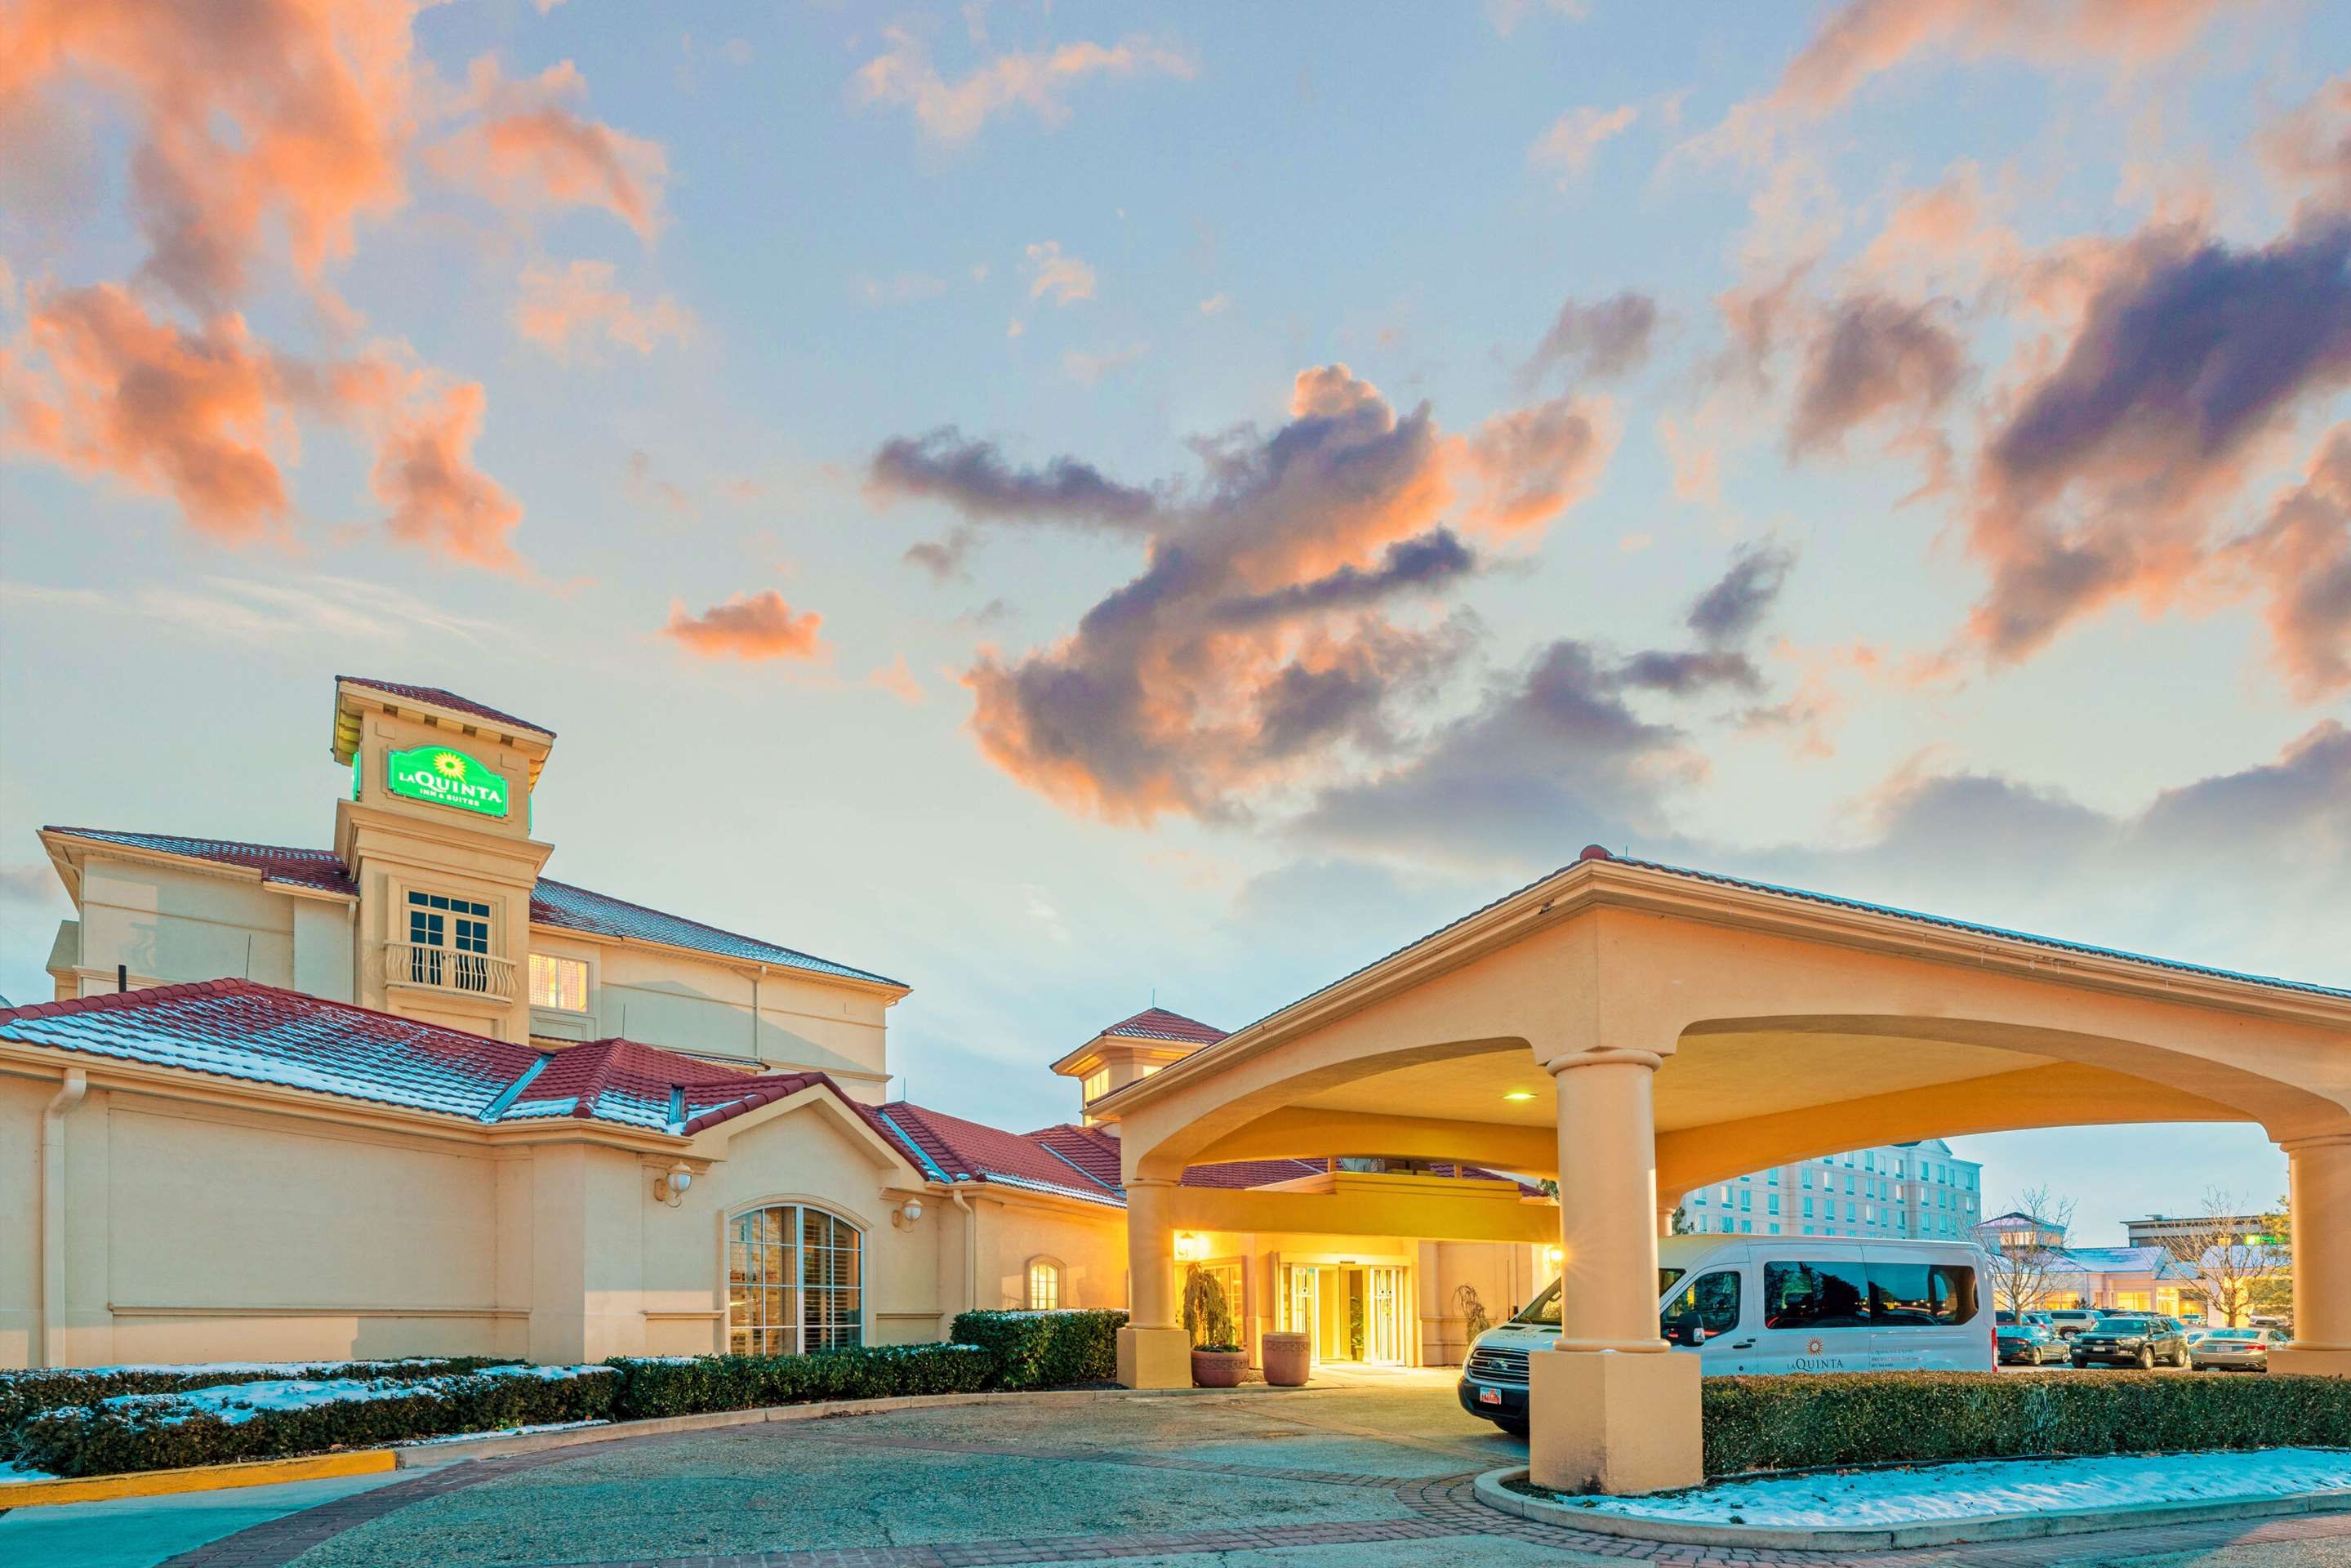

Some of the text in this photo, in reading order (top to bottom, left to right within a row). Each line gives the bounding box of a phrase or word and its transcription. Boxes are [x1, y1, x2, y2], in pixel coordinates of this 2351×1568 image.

[399, 771, 502, 804] LA QUINTA
[420, 788, 437, 797] INN
[446, 794, 480, 807] SUITES
[1796, 1358, 1843, 1372] QUINTA
